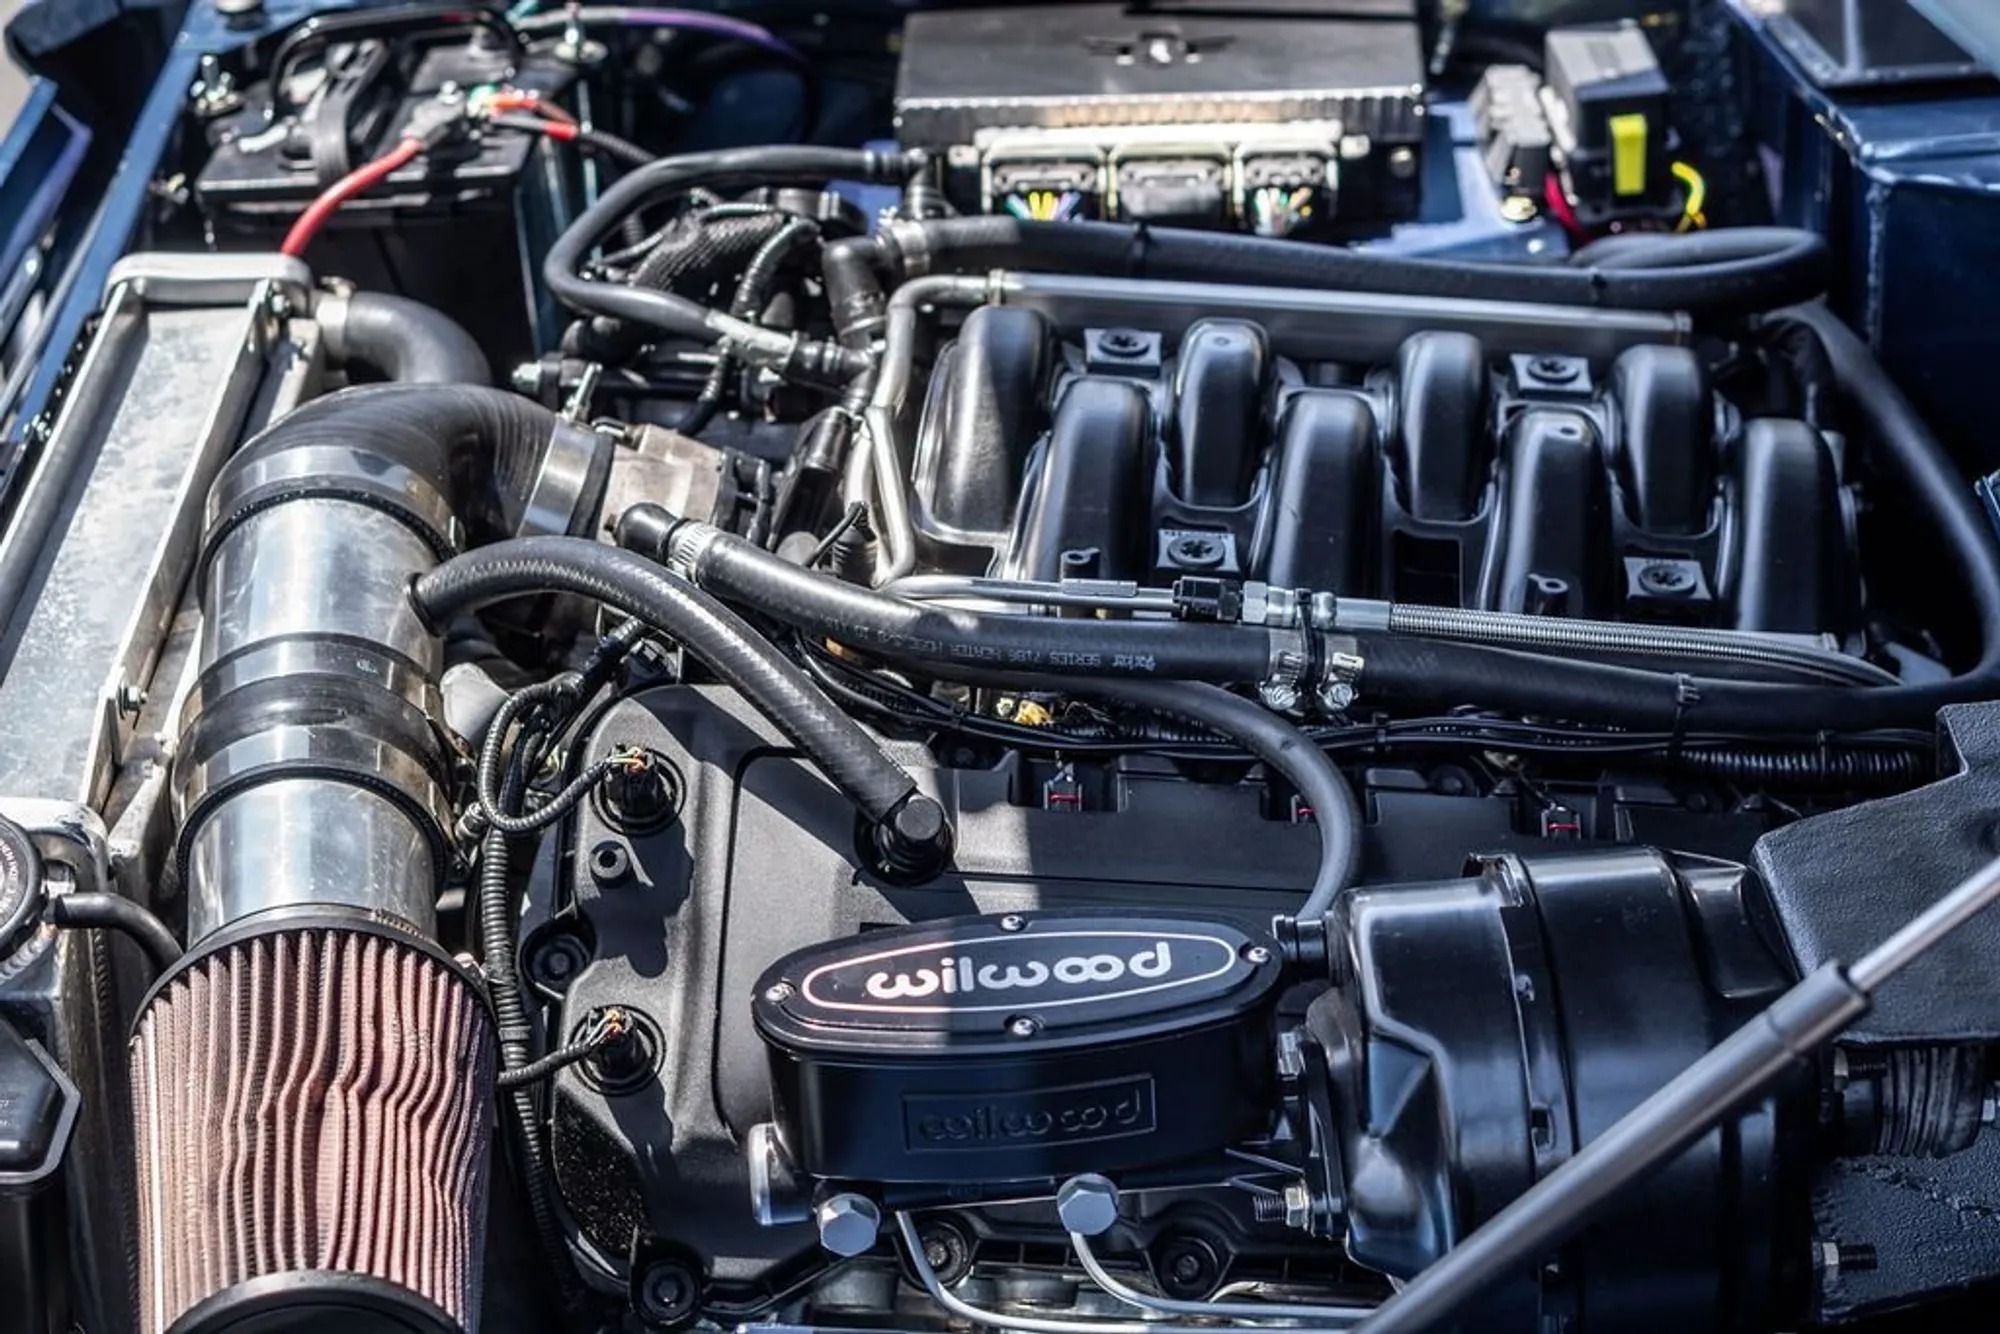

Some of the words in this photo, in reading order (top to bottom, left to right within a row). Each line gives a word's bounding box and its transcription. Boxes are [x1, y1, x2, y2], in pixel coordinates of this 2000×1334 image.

[1050, 651, 1101, 667] SERIES
[1112, 653, 1156, 671] Parker
[866, 942, 1171, 999] wilwood
[919, 1088, 1140, 1140] wilwood
